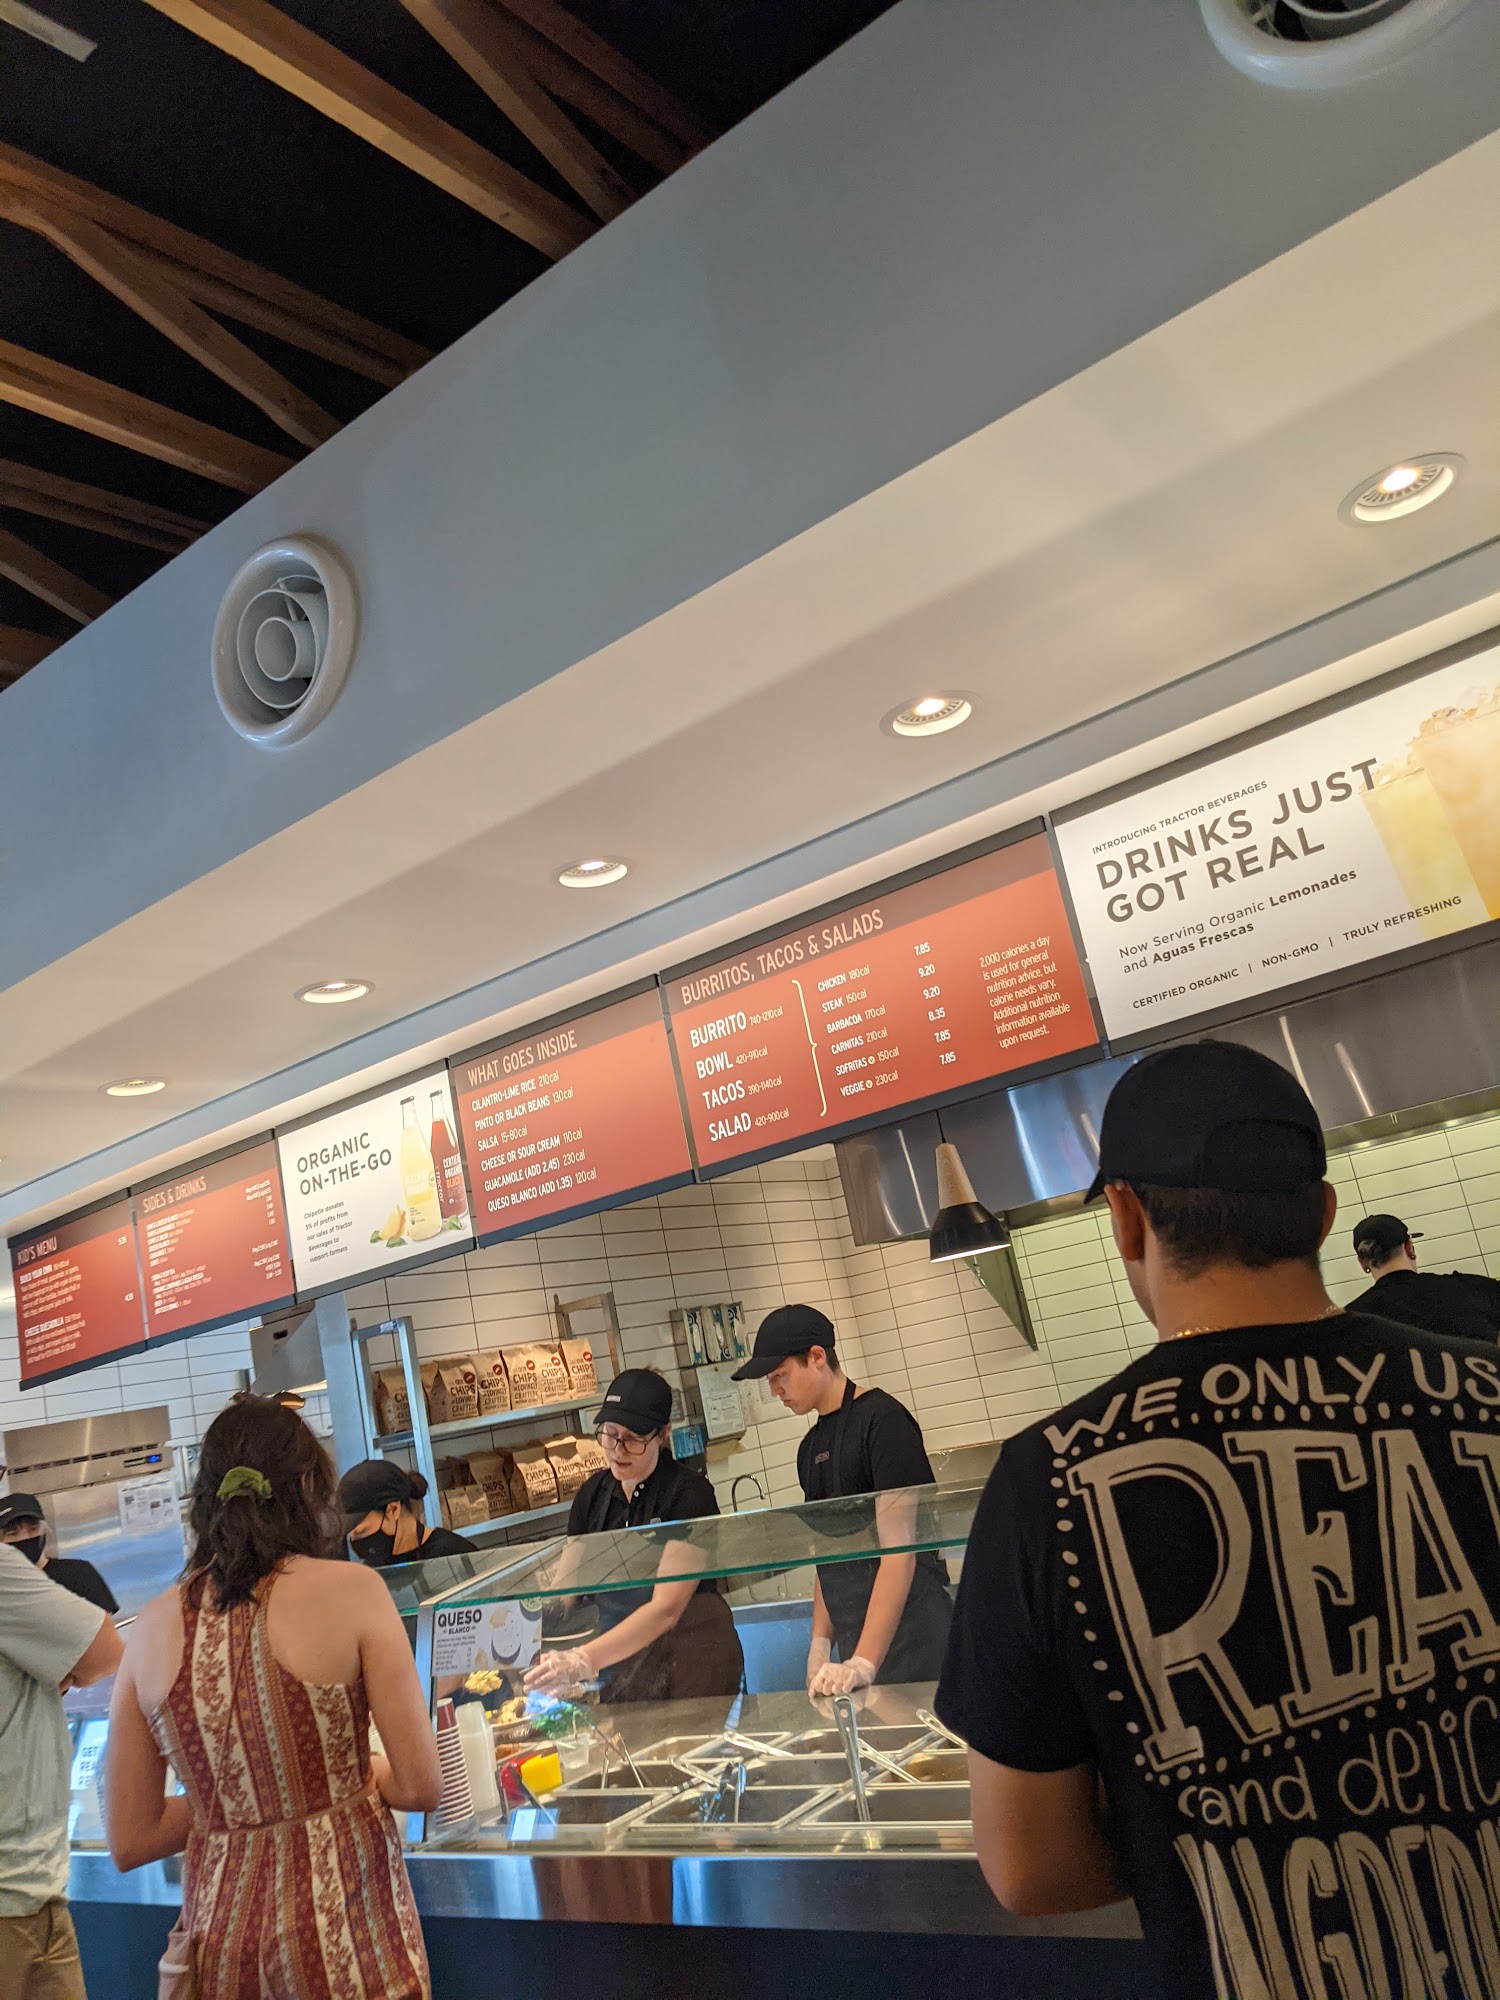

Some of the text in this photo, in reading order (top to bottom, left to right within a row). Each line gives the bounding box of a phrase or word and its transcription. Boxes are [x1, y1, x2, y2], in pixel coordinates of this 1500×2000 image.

[1092, 781, 1268, 854] INTRODUCING TRACTOR BEVERAGES
[1096, 758, 1380, 889] DRINKS JUST
[1106, 826, 1325, 923] GOT REAL
[1119, 869, 1357, 959] Now Serving Organic Lemonades
[681, 909, 883, 1005] BURRITOS, TACOS & SALADS
[914, 943, 930, 956] 7.85
[1001, 941, 1029, 960] calories
[1030, 941, 1035, 949] a
[1036, 936, 1050, 947] day
[1124, 922, 1255, 974] and Aguas Frescas
[1133, 896, 1462, 1009] CERTIFIED ORGANIC NON-GMO TRULY REFRESHING
[918, 964, 935, 978] 9.20
[983, 950, 1048, 981] is used for general
[818, 974, 846, 992] CHICKEN
[986, 962, 1057, 994] nutrition advice, but
[923, 986, 940, 1000] 9.20
[990, 979, 1056, 1007] calorie needs vary.
[822, 997, 844, 1012] STEAK
[928, 1008, 945, 1021] 8.35
[993, 992, 1061, 1021] Additional nutrition
[827, 1014, 862, 1034] BARBACOA
[996, 1004, 1070, 1034] information available
[690, 1012, 746, 1048] BURRITO
[934, 1030, 951, 1043] 7.85
[999, 1024, 1049, 1049] upon request.
[831, 1036, 863, 1054] CARNITAS
[468, 1030, 577, 1086] WHAT GOES INSIDE
[696, 1051, 733, 1079] BOWL
[836, 1057, 867, 1075] SOFRITAS
[939, 1052, 956, 1065] 7.85
[472, 1087, 520, 1111] CILANTRO-LIME
[521, 1079, 536, 1094] RICE
[702, 1080, 745, 1109] TACOS
[840, 1081, 865, 1096] VEGGIE
[475, 1113, 494, 1131] PINTO
[495, 1111, 504, 1124] OR
[506, 1103, 527, 1120] BLACK
[528, 1095, 550, 1114] BEANS
[709, 1113, 751, 1141] SALAD
[297, 1133, 370, 1173] ORGANIC
[478, 1135, 499, 1151] SALSA
[481, 1154, 506, 1171] CHEESE
[507, 1149, 516, 1163] OR
[517, 1143, 536, 1159] SOUR
[537, 1135, 560, 1153] CREAM
[300, 1149, 391, 1195] ON-THE-GO
[485, 1169, 523, 1192] GUACAMOLE
[525, 1163, 541, 1179] (ADD
[142, 1176, 206, 1213] SIDES & DRINKS
[488, 1195, 509, 1212] QUESO
[511, 1184, 537, 1205] BLANCO
[539, 1182, 555, 1197] (ADD
[557, 1177, 572, 1193] 1.35)
[304, 1201, 344, 1219] Chipotle donates
[316, 1230, 328, 1238] sales
[335, 1221, 352, 1230] Tractor
[320, 1216, 335, 1226] profits
[36, 1237, 57, 1257] MENU
[308, 1240, 333, 1252] Beverages
[310, 1246, 348, 1263] support farmers
[513, 1373, 537, 1383] CHIPS
[542, 1368, 562, 1377] CHIPS
[572, 1364, 594, 1374] CHIPS
[451, 1385, 475, 1396] CHIPS
[481, 1378, 505, 1389] CHIPS
[1043, 1378, 1182, 1454] WE
[1201, 1352, 1386, 1405] ONLY
[558, 1463, 581, 1474] CHIPS
[585, 1457, 606, 1468] CHIPS
[526, 1468, 550, 1482] CHIPS
[483, 1482, 504, 1492] CHIPS
[438, 1609, 482, 1627] QUESO
[449, 1626, 469, 1634] BLANCO
[1199, 1756, 1317, 1827] and
